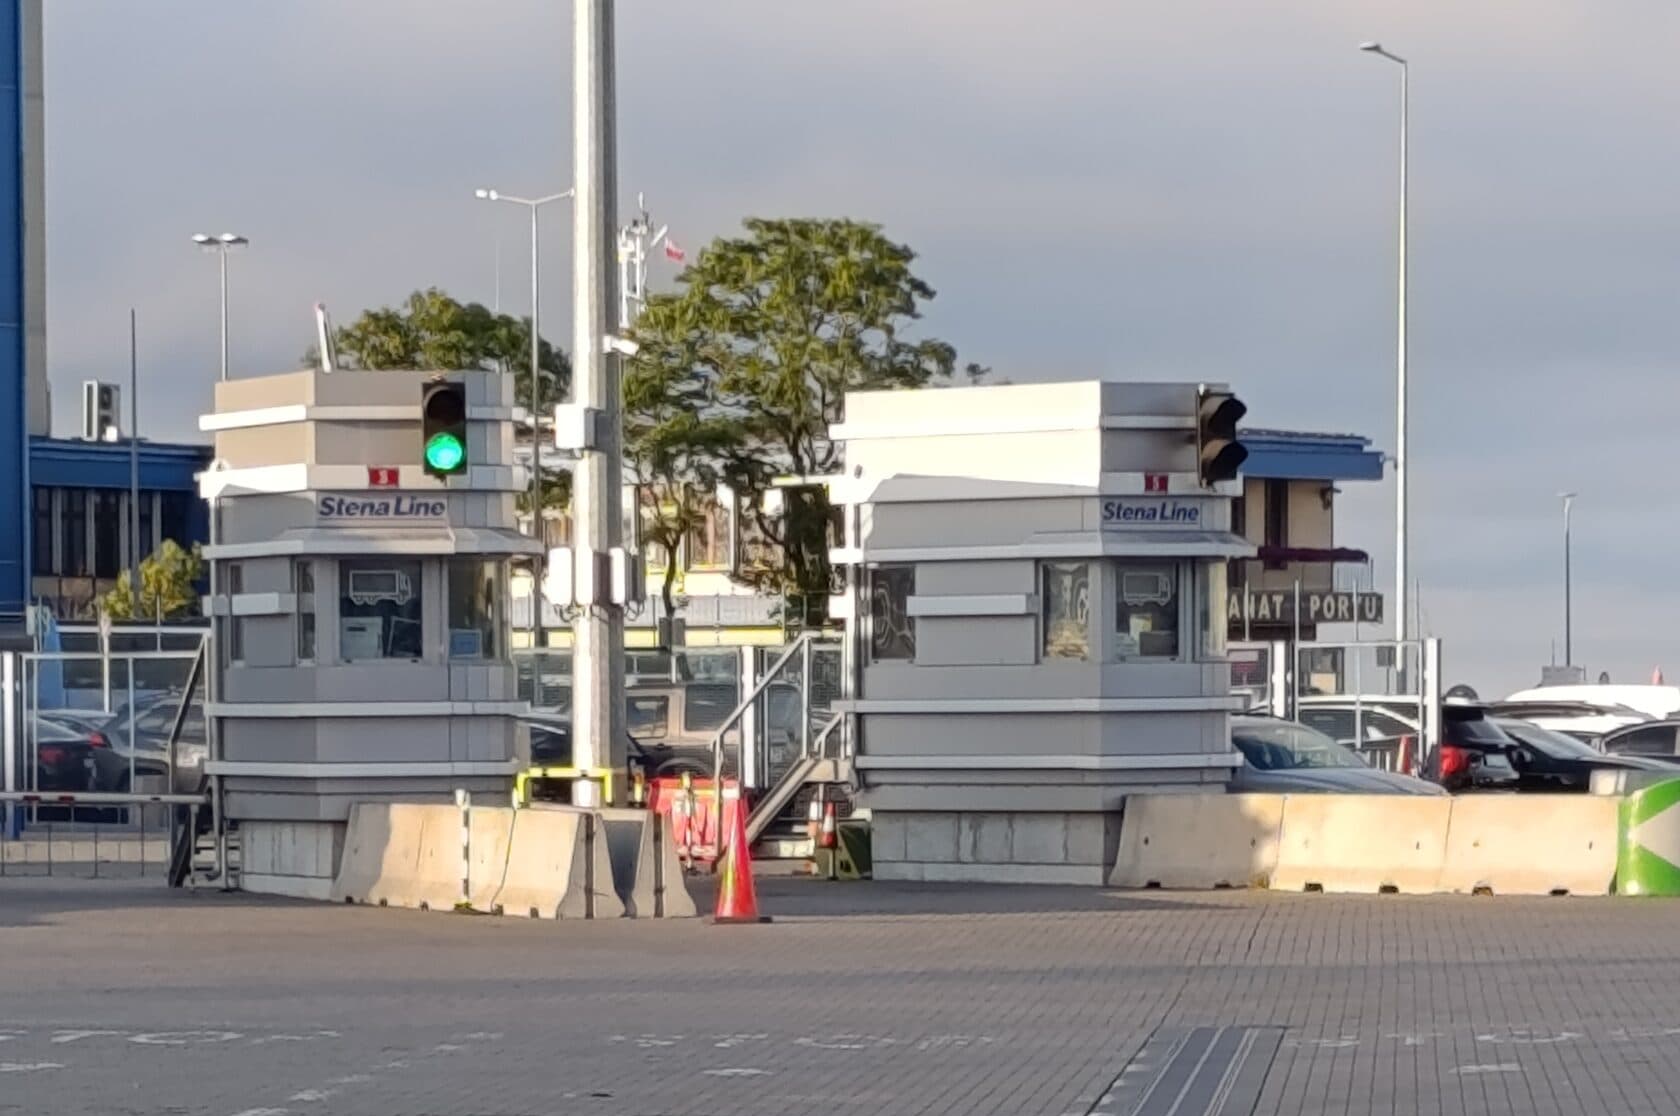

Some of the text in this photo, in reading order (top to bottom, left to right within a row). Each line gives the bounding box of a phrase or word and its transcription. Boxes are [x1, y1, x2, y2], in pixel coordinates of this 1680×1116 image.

[319, 495, 446, 517] Stena Line
[1103, 501, 1199, 522] Stena Line
